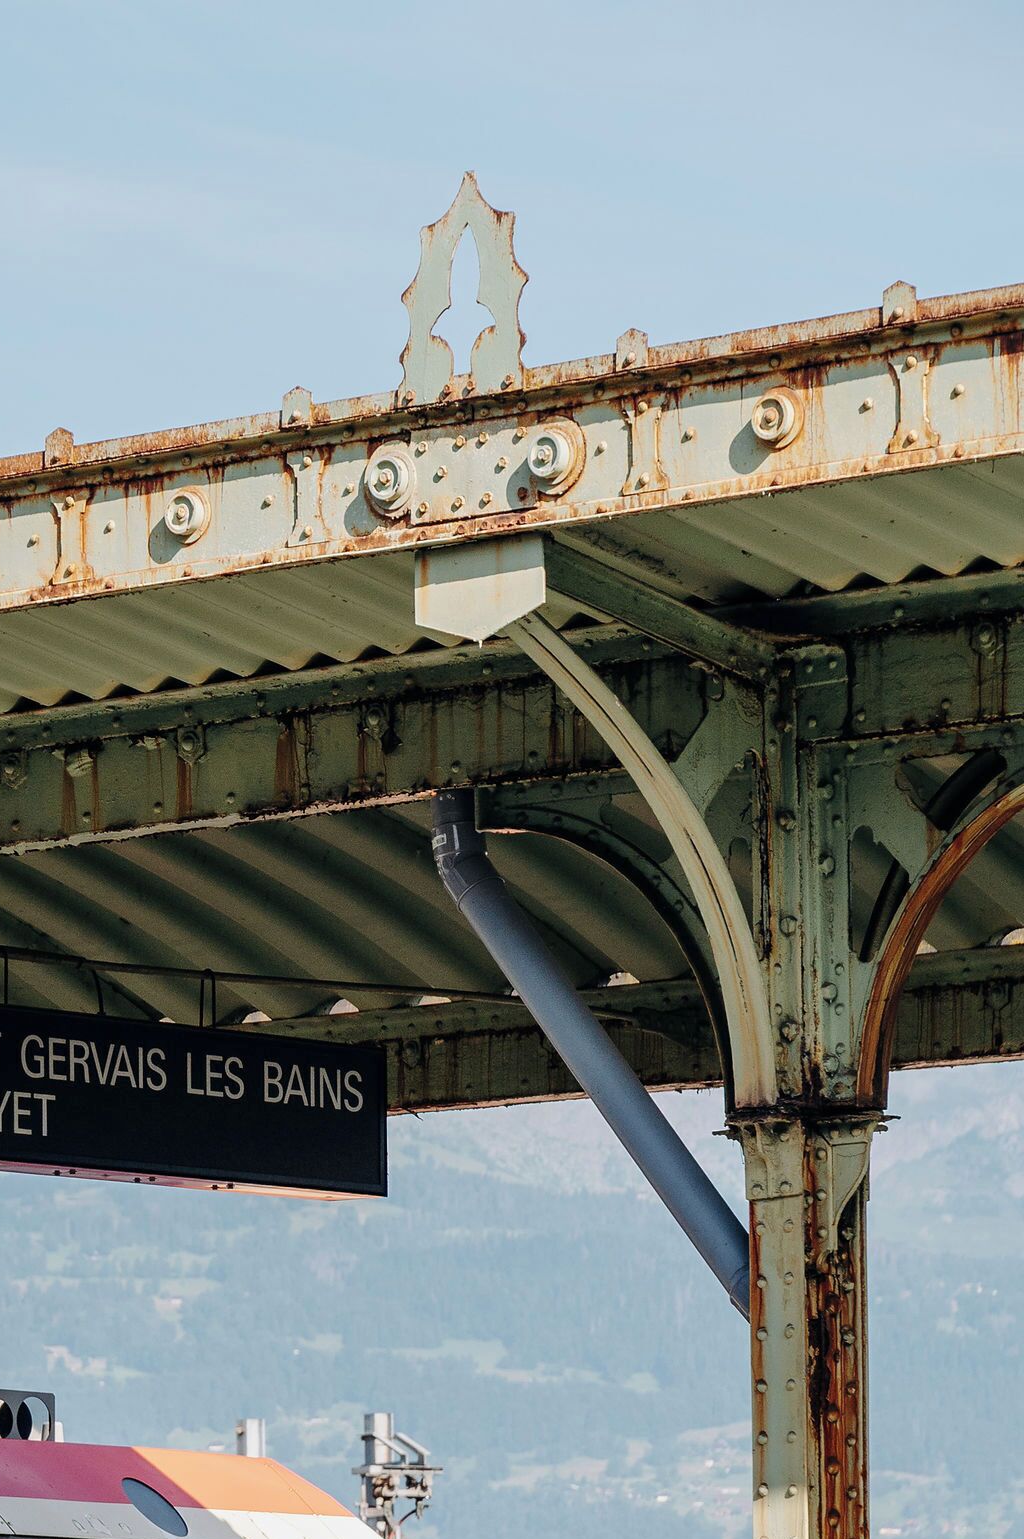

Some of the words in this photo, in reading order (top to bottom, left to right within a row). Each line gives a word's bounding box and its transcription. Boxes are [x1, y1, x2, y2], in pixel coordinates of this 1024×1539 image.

[20, 1034, 168, 1092] GERVAIS
[186, 1052, 245, 1100] LES
[263, 1060, 364, 1113] BAINS
